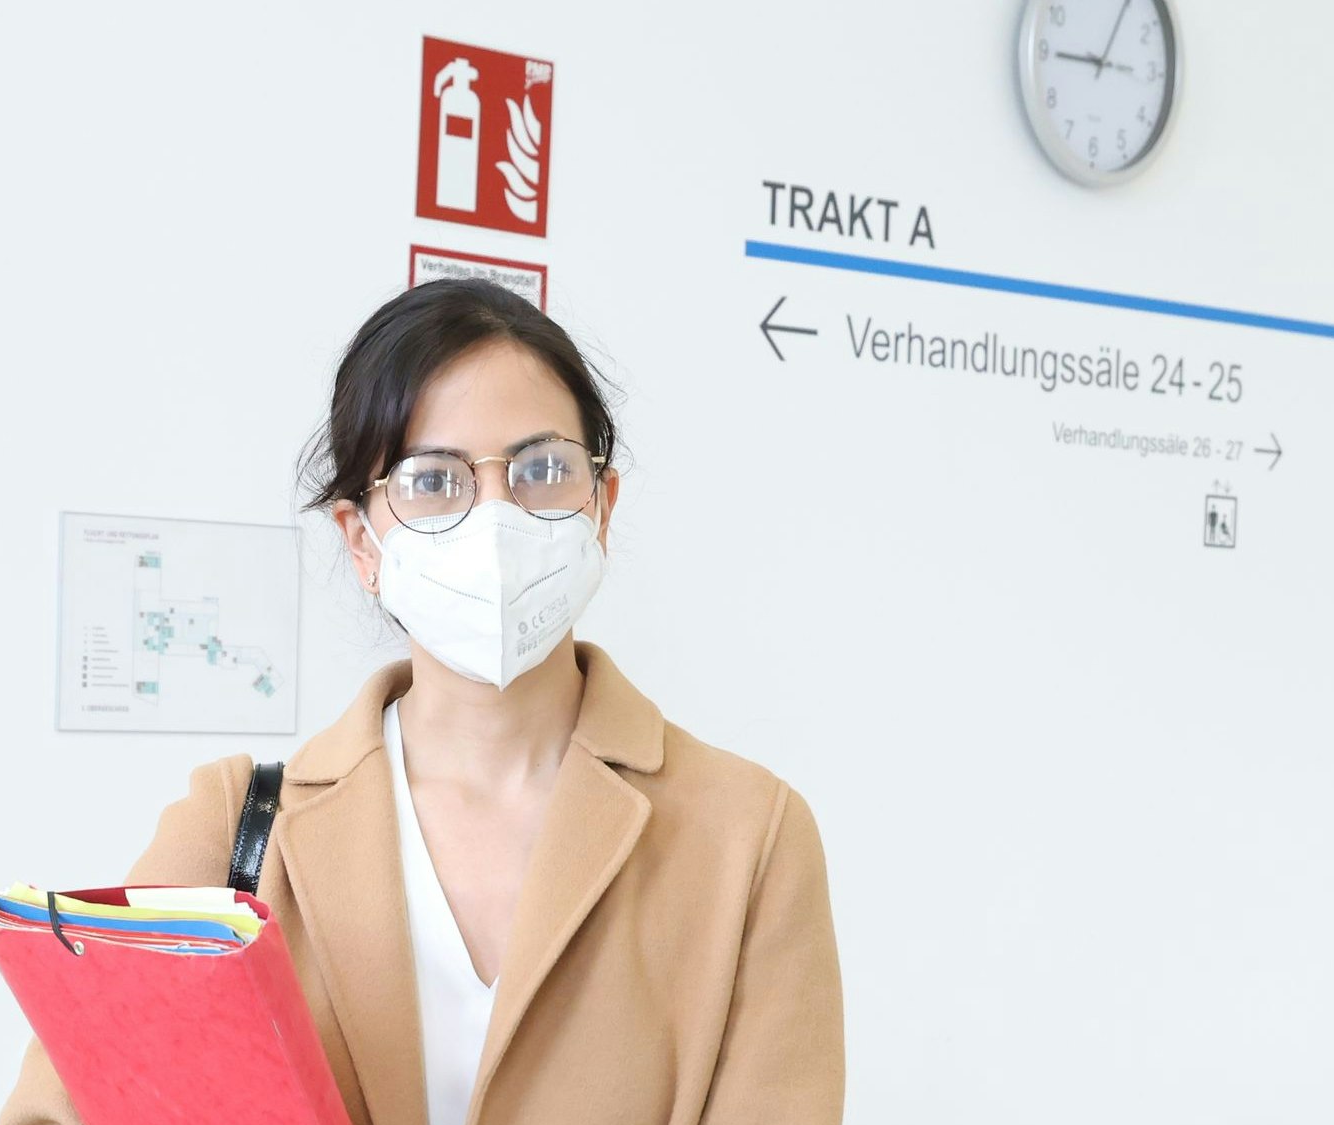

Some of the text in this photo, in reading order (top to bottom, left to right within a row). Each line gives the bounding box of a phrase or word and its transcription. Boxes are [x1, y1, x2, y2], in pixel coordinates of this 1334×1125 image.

[1140, 24, 1151, 45] 2
[1039, 38, 1049, 61] 9
[1046, 87, 1057, 109] 8
[1065, 119, 1074, 139] 7
[1117, 129, 1127, 150] 5
[1088, 136, 1099, 158] 6
[762, 180, 935, 249] TRAKT A
[846, 314, 1140, 392] Verhandlungssäle
[1052, 421, 1188, 458] Verhandlungssäle
